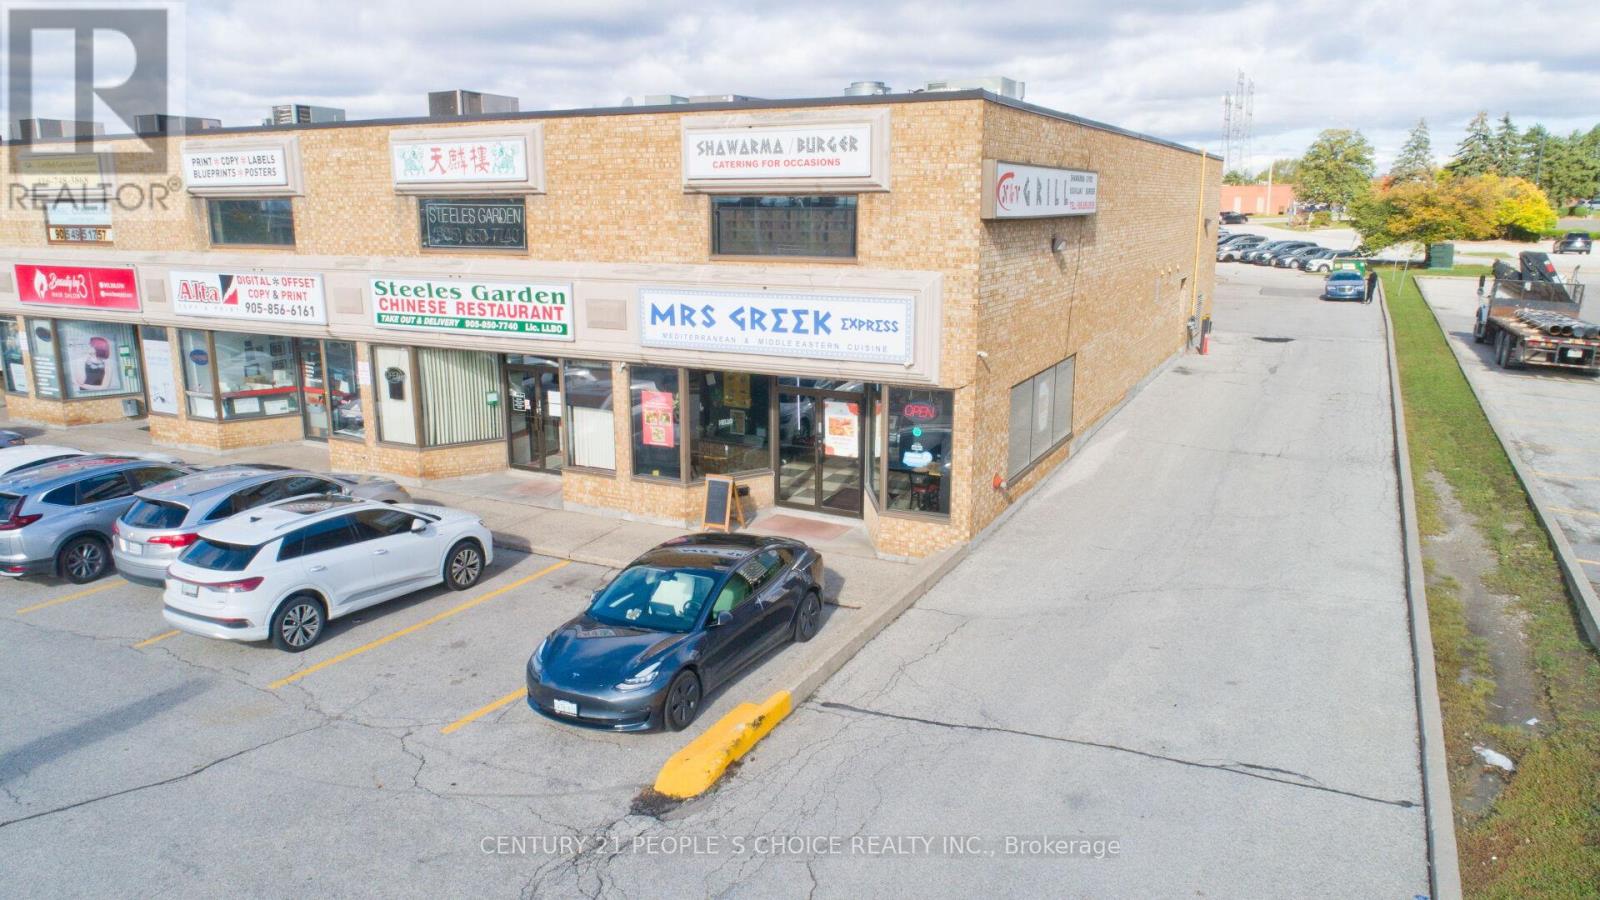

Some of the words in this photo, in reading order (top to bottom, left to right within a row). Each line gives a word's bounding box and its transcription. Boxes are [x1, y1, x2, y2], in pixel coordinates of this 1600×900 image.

[696, 138, 784, 156] SHAWARMA
[797, 135, 858, 154] BURGER
[191, 157, 212, 166] PRINT
[221, 156, 239, 165] COPY
[247, 154, 276, 165] LABELS
[712, 160, 759, 169] CATERING
[762, 159, 780, 168] FOR
[784, 158, 841, 168] OCCASIONS
[193, 168, 236, 179] BLUEPRINTS
[245, 167, 277, 177] POSTERS
[1023, 176, 1068, 207] GRILL
[429, 207, 476, 224] STEELES
[478, 207, 521, 224] GARDEN
[236, 275, 271, 287] DIGITAL
[281, 277, 315, 288] OFFSET
[178, 279, 221, 304] Alta
[248, 289, 270, 300] COPY
[273, 290, 279, 300] &
[281, 291, 307, 302] PRINT
[374, 281, 462, 300] Steeles
[472, 285, 566, 305] Garden
[245, 302, 315, 317] 905-856-6161
[379, 297, 447, 315] CHINESE
[456, 300, 564, 321] RESTAURANT
[651, 303, 717, 329] MRS
[381, 314, 400, 324] TAKE
[401, 315, 416, 325] OUT
[424, 317, 460, 328] DELIVERY
[465, 319, 518, 331] 905-850-7740
[525, 322, 540, 332] Lic.
[541, 323, 563, 333] LLBO
[904, 404, 936, 421] OPEN
